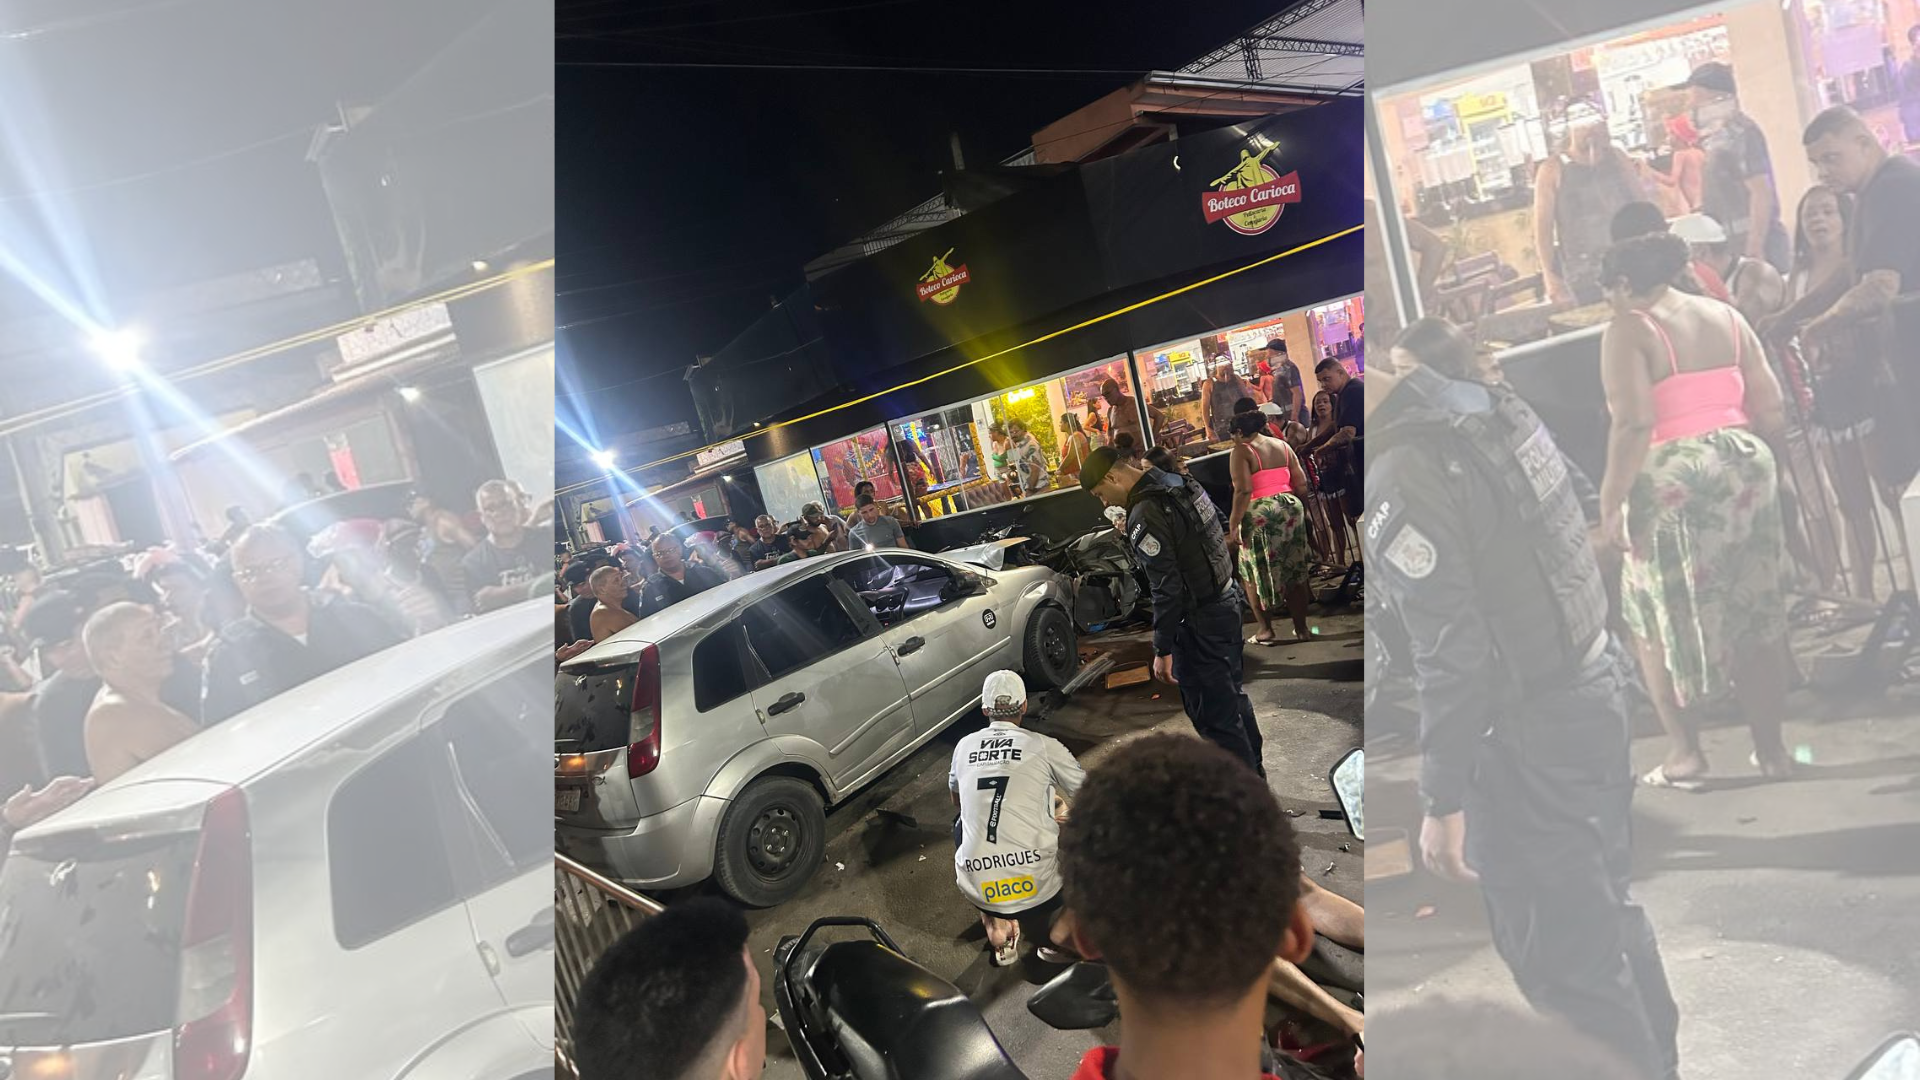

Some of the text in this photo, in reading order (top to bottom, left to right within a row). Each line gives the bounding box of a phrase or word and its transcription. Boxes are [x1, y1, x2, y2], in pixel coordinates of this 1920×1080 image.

[1208, 196, 1247, 212] Boteco
[1250, 184, 1295, 203] Carioca
[920, 282, 940, 296] Boteco
[941, 271, 967, 286] Carioca
[1367, 501, 1391, 539] CFAP
[980, 738, 1014, 749] VIVA
[969, 748, 1022, 764] SORTE
[977, 776, 1010, 844] 7
[965, 849, 1042, 873] RODRIGUES
[984, 880, 1034, 903] placo
